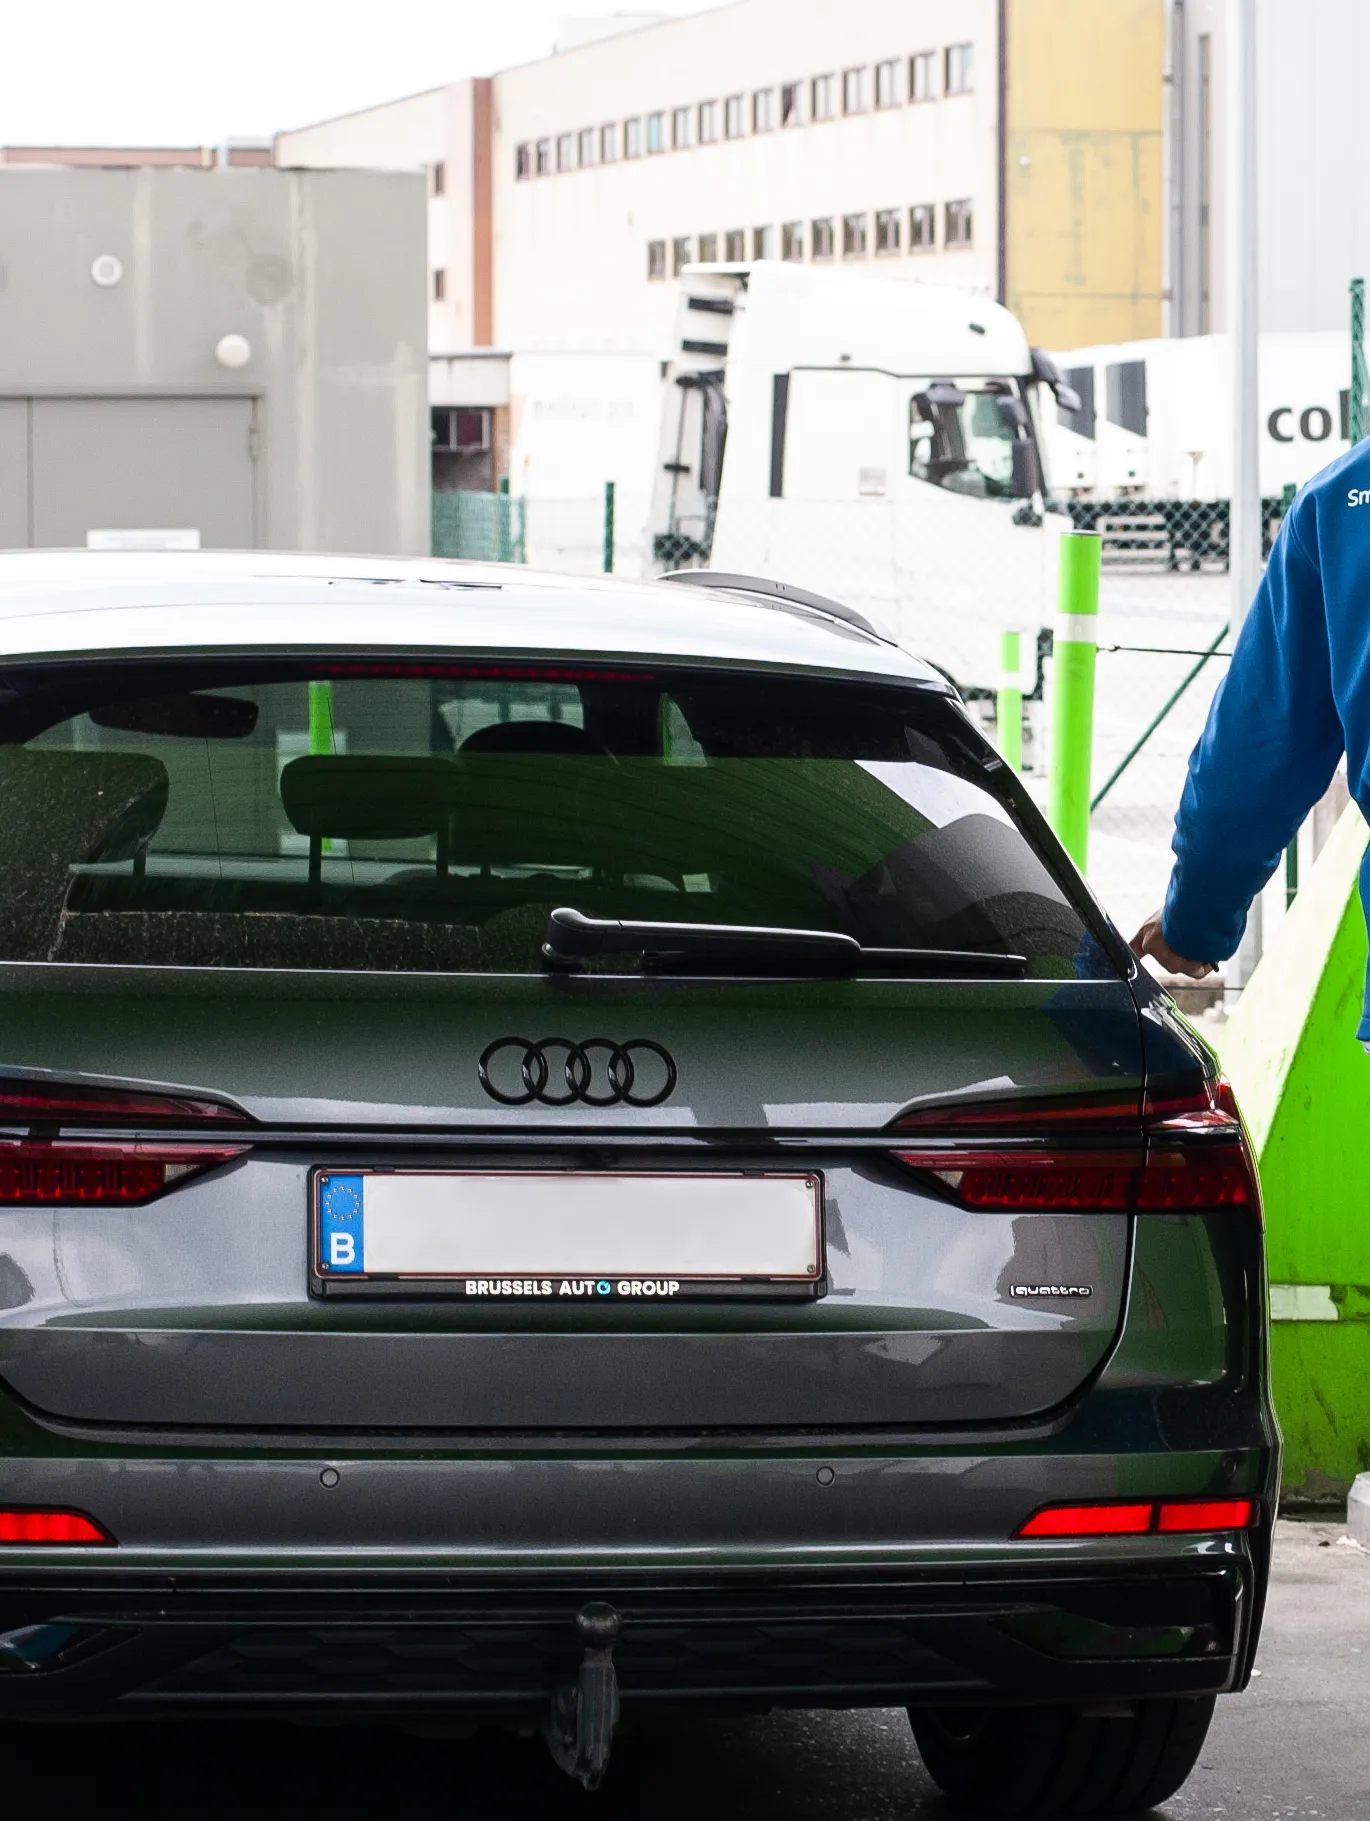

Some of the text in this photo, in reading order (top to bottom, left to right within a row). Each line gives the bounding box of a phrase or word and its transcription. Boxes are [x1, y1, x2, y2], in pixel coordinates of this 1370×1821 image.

[330, 1232, 356, 1264] B
[465, 1280, 681, 1297] BRUSSELS AUTO GROUP
[1015, 1285, 1090, 1297] quattro
